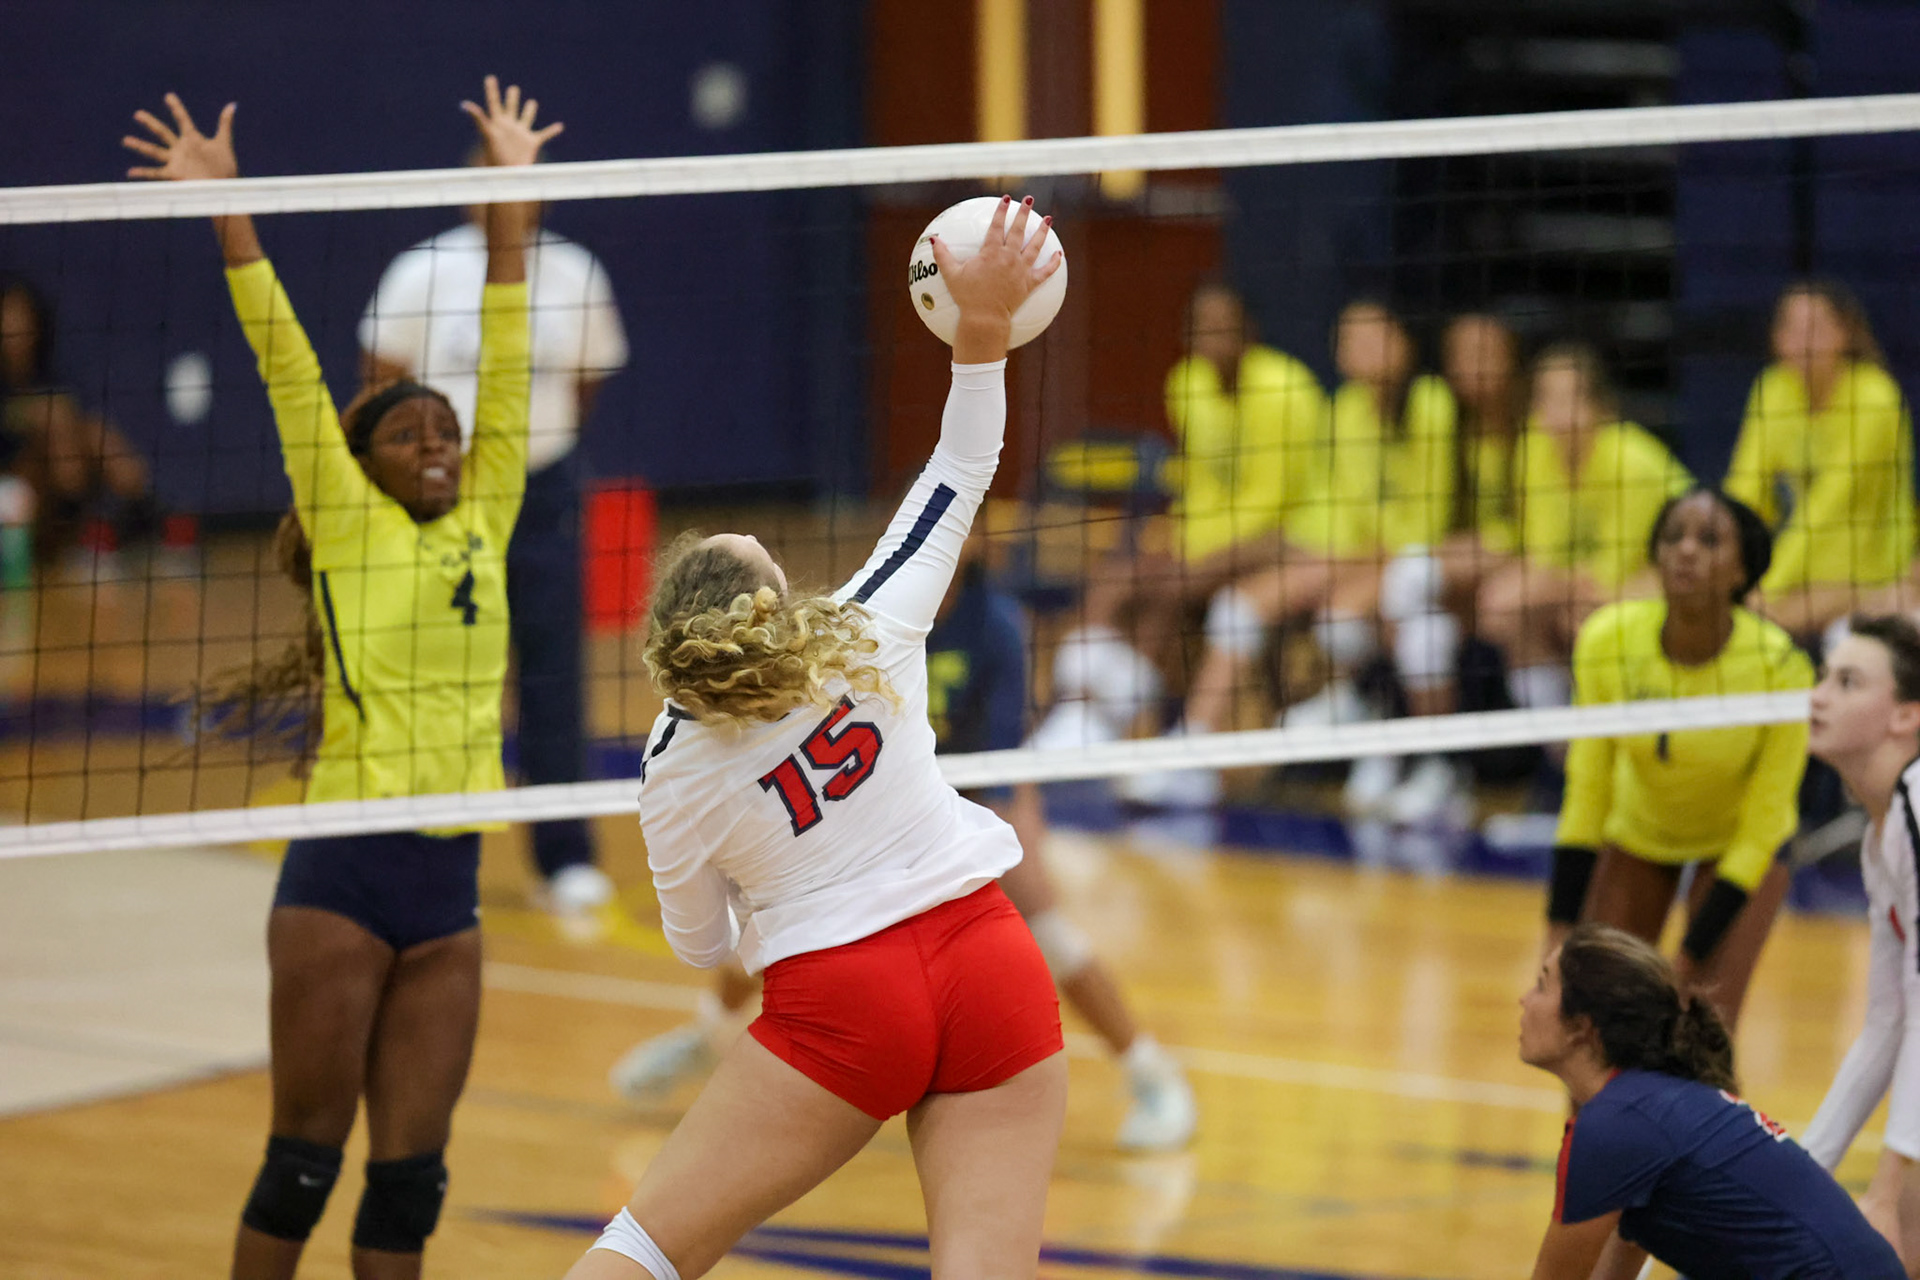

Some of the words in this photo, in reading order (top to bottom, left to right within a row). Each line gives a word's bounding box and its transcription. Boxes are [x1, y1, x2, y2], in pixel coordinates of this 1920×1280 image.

[908, 260, 938, 286] Wilso
[451, 569, 478, 625] 4
[757, 694, 883, 837] 15
